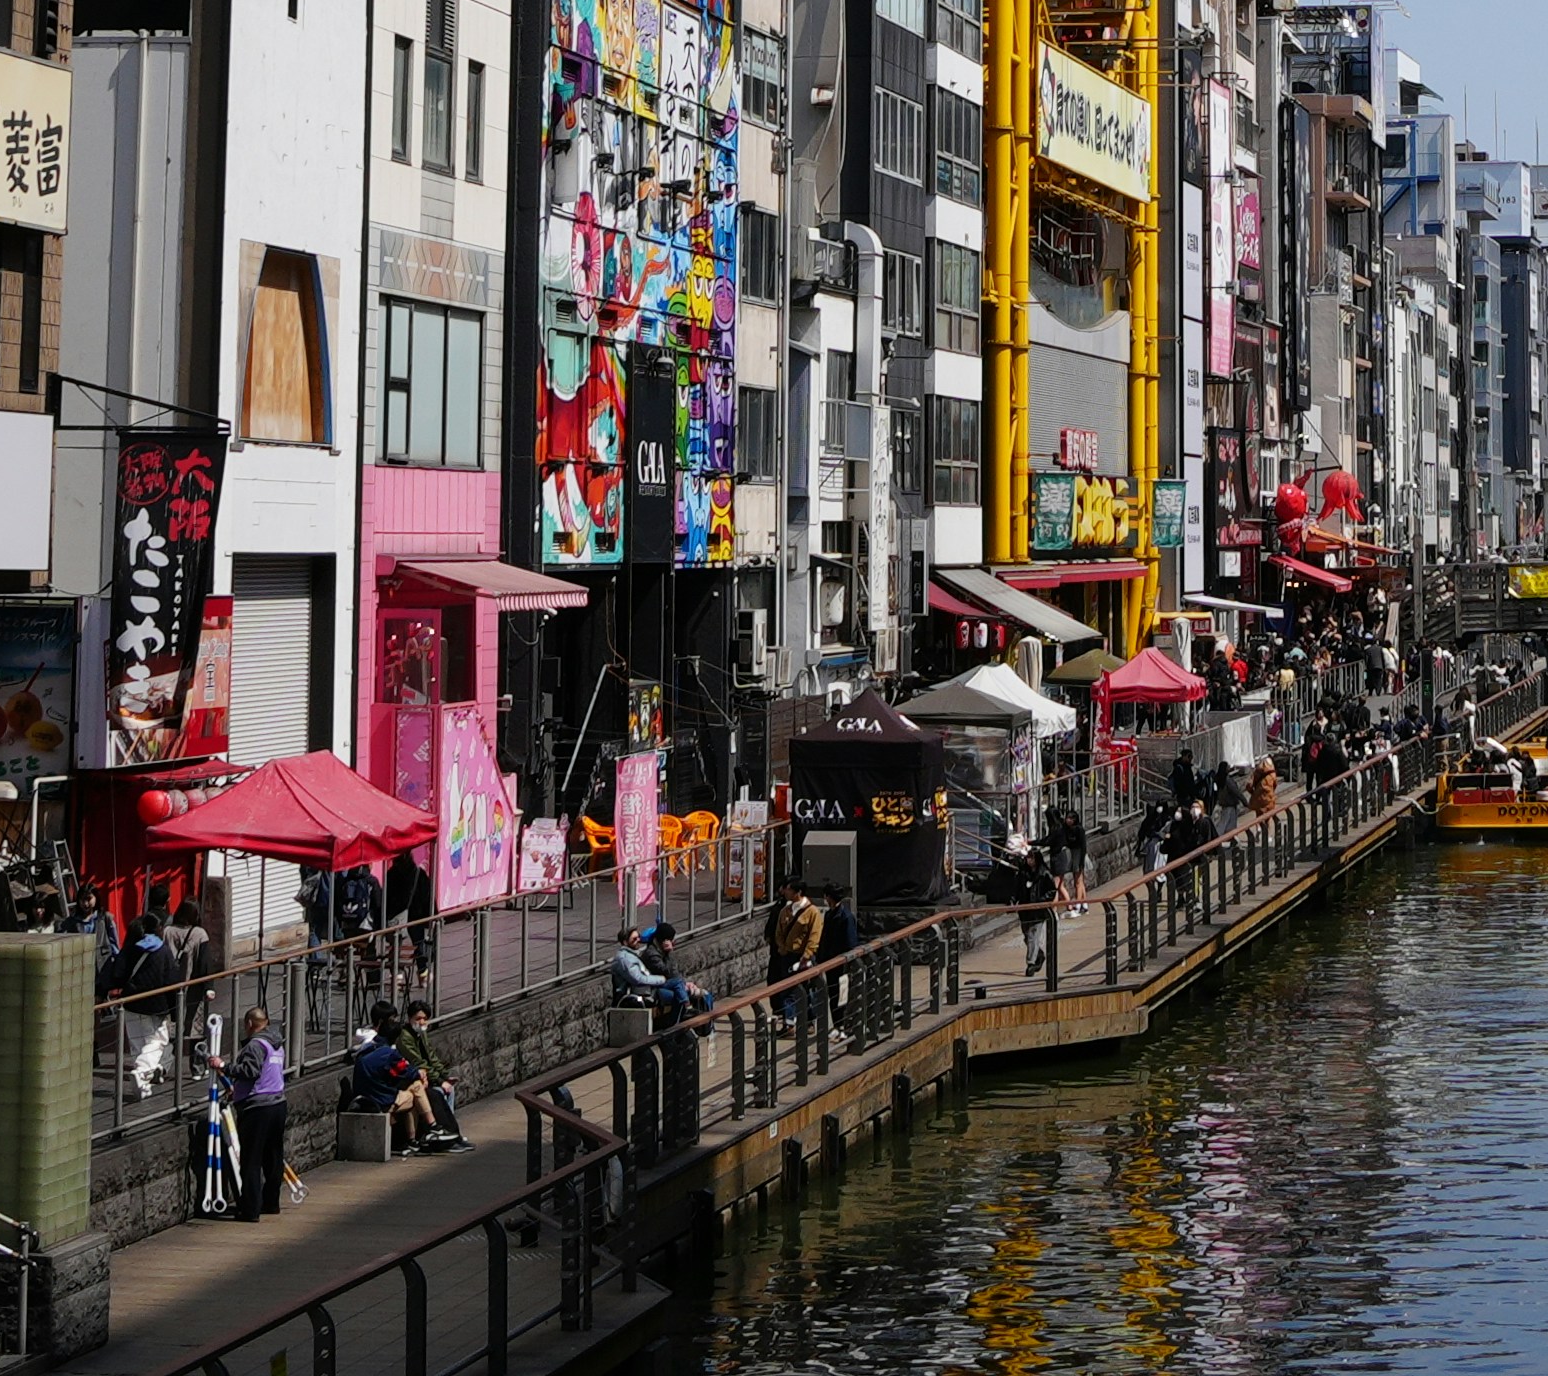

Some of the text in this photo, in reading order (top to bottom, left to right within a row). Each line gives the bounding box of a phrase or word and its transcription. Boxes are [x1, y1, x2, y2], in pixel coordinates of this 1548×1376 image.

[2, 110, 64, 197] 菱富
[170, 447, 214, 543] 大阪
[116, 506, 170, 716] たこやき
[170, 552, 186, 659] TAKOYAKI
[794, 798, 846, 819] GALA
